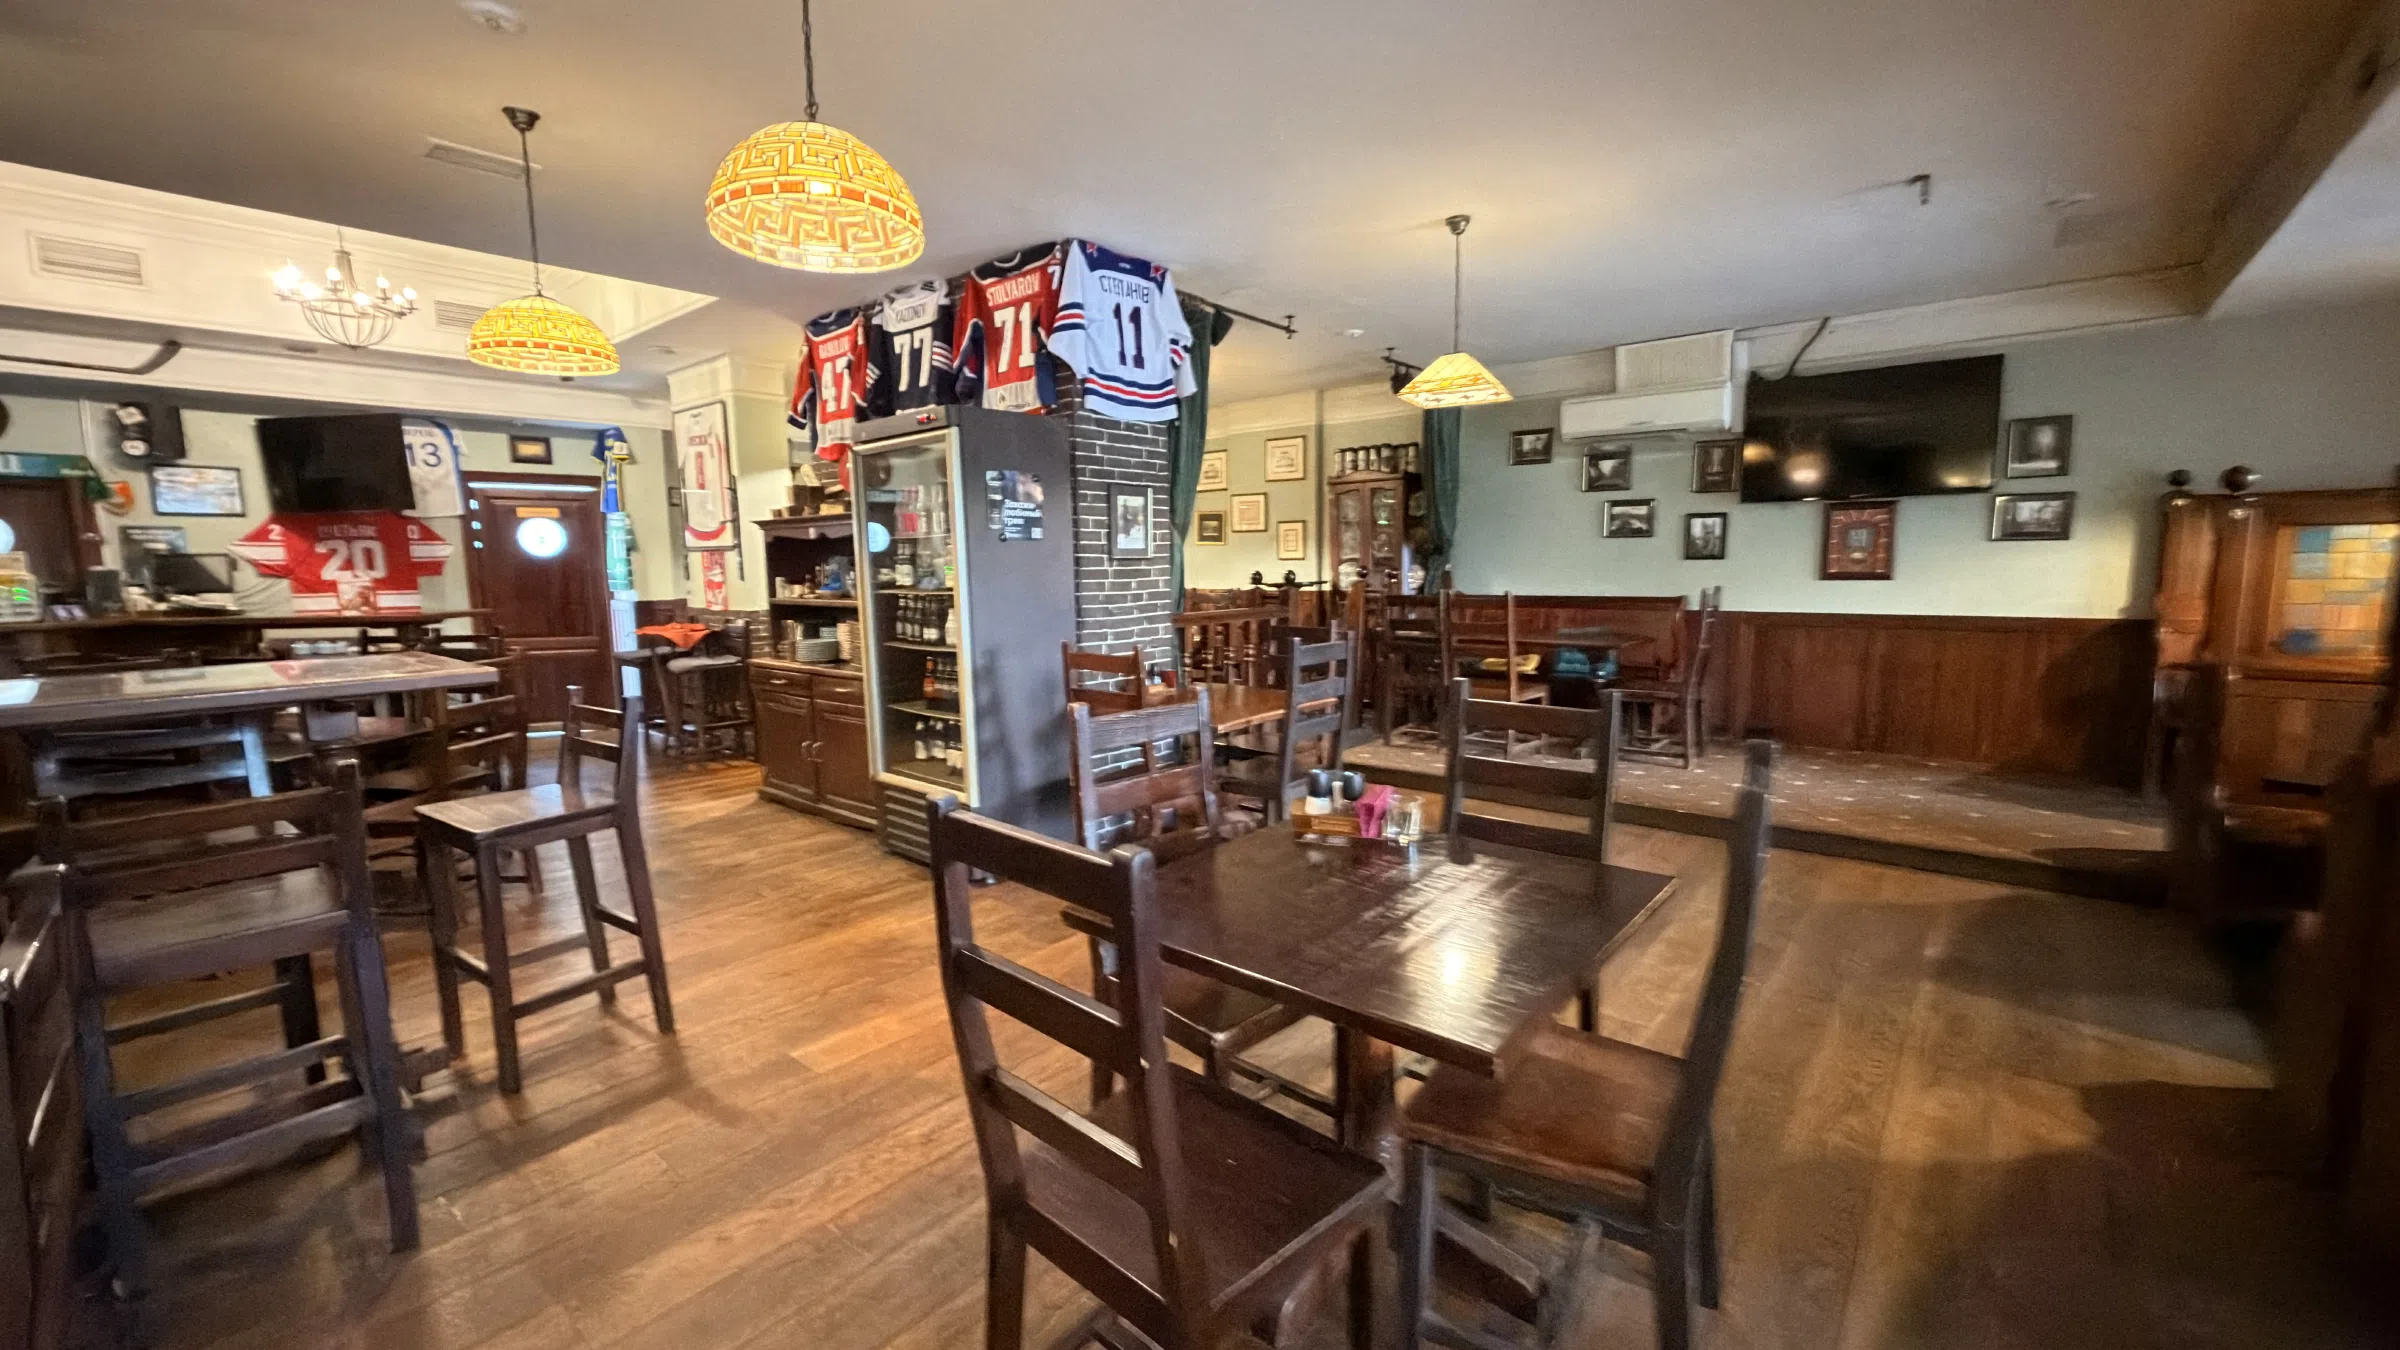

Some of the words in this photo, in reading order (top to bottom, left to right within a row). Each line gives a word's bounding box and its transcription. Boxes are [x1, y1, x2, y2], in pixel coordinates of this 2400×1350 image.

[986, 272, 1041, 307] STOLYAROV
[893, 328, 934, 392] 77
[993, 300, 1034, 373] 71
[1113, 302, 1145, 369] 11
[821, 356, 852, 413] 47
[315, 539, 388, 582] 20
